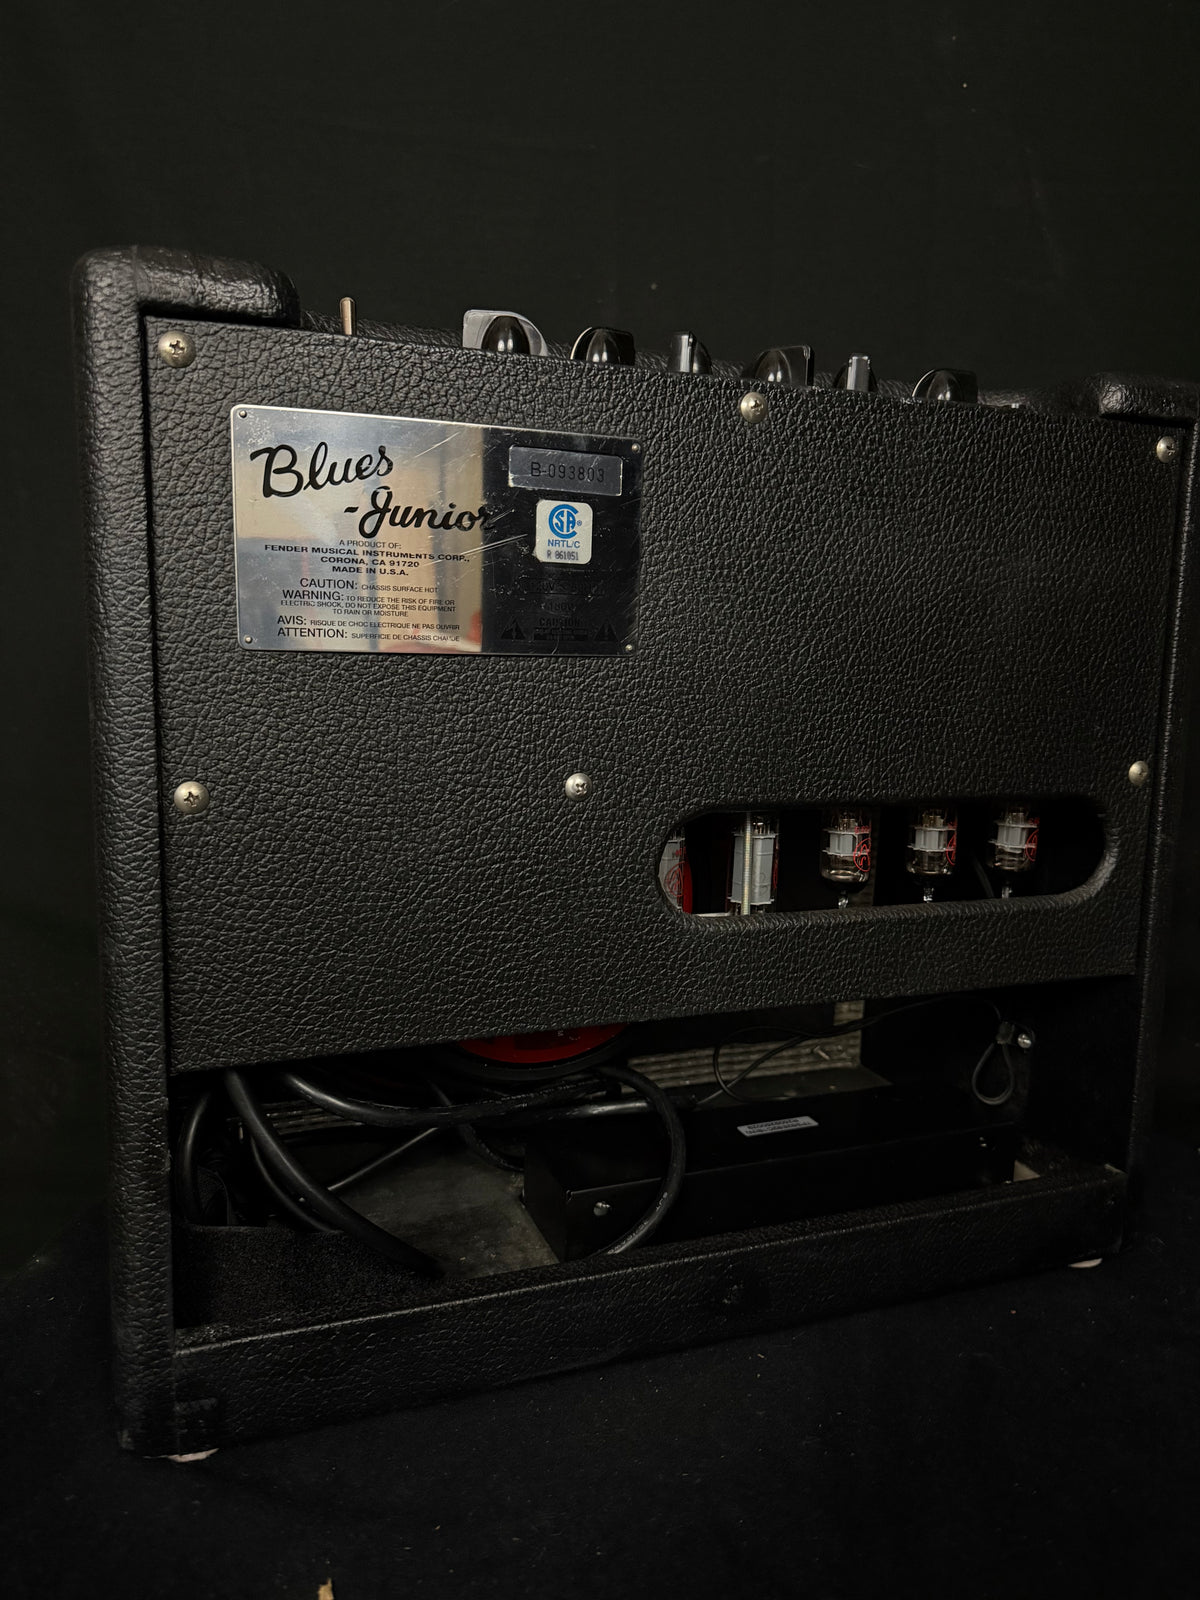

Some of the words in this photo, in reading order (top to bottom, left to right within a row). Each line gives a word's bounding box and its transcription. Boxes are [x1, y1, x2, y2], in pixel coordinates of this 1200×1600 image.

[250, 441, 394, 497] Blues
[530, 461, 605, 482] B-093803
[547, 539, 580, 548] NRTL/C
[312, 547, 359, 555] MUSICAL
[362, 550, 434, 560] INSTRUMENTS
[320, 556, 368, 565] CORONA,
[300, 578, 358, 590] CAUTION:
[282, 590, 344, 601] WARNING:
[278, 616, 306, 626] AVIS:
[278, 628, 348, 638] ATTENTION:
